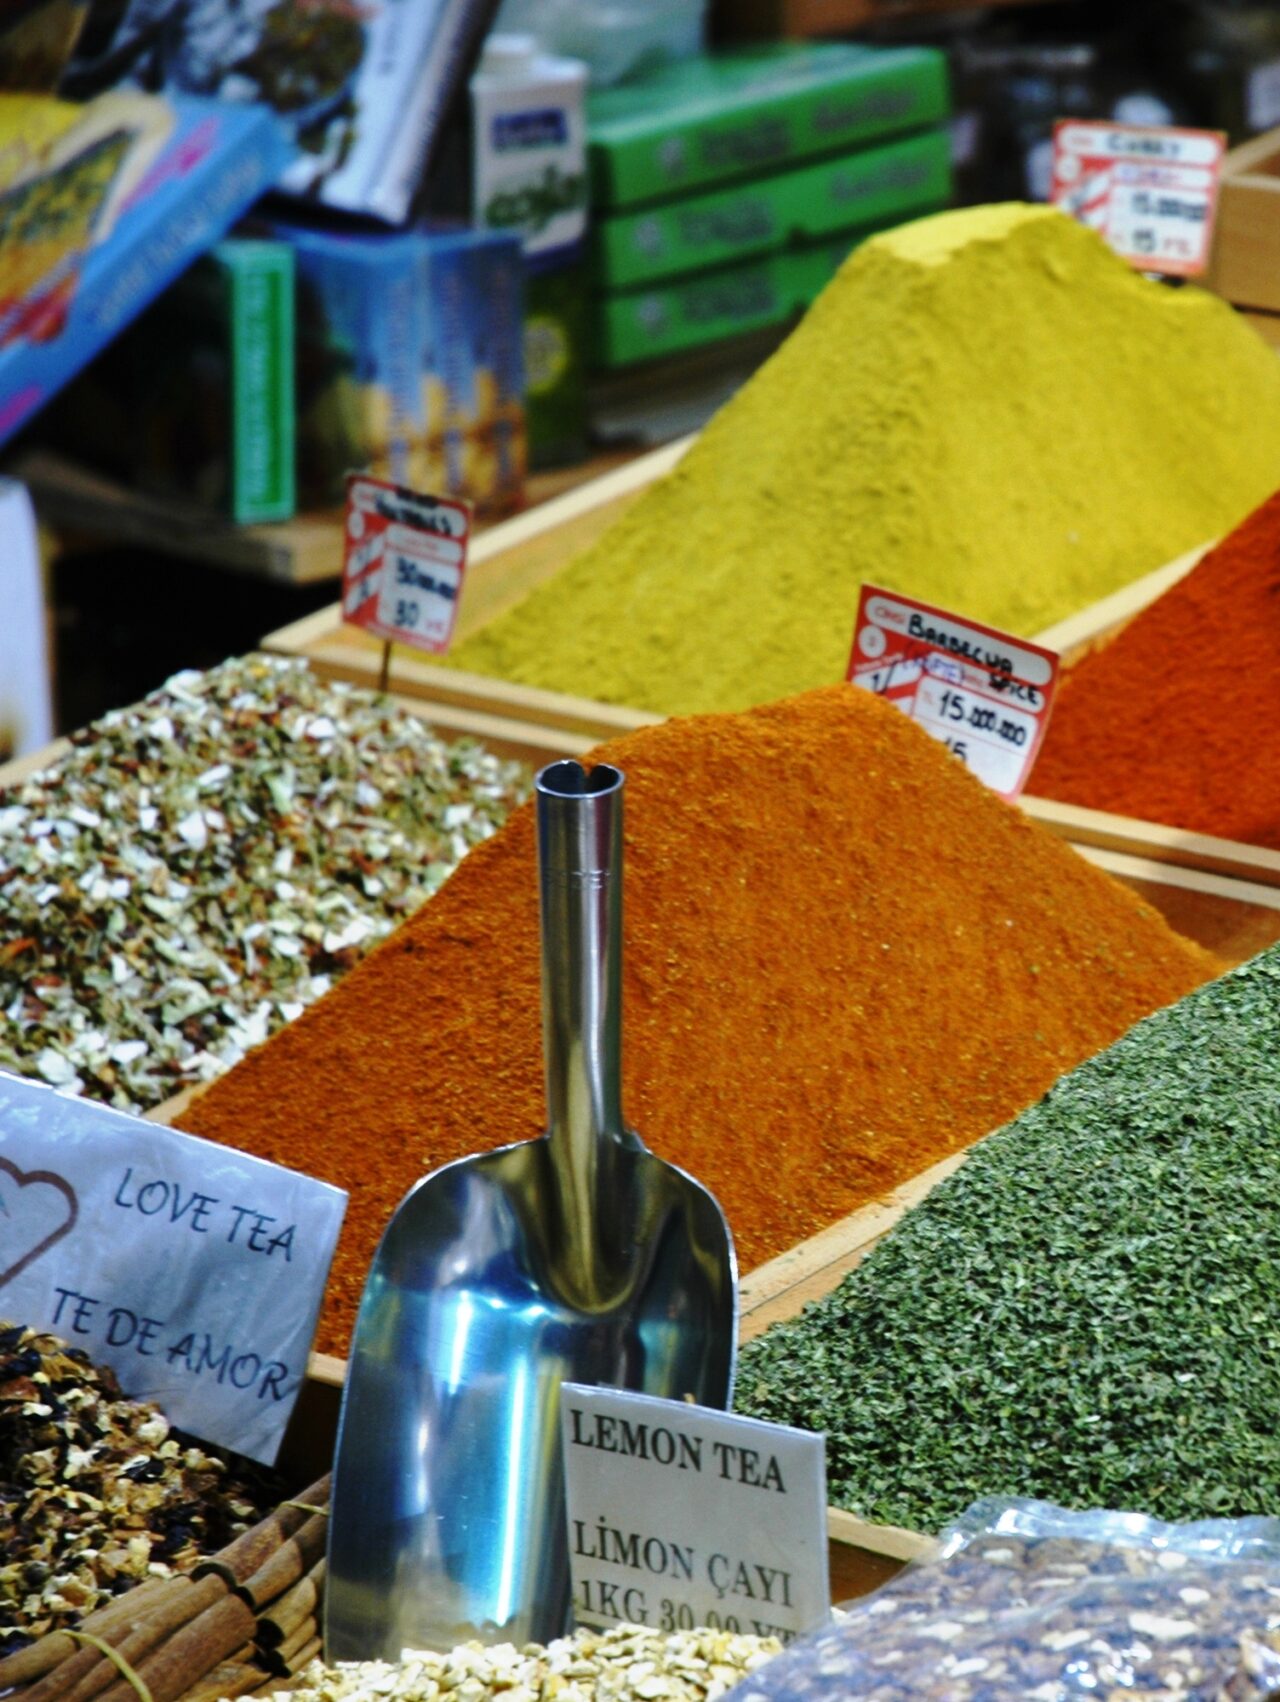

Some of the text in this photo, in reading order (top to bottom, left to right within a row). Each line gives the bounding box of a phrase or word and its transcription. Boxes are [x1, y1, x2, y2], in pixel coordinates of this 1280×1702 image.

[113, 1168, 298, 1262] LOVE TEA
[52, 1287, 290, 1400] TE DE AMOR
[570, 1409, 787, 1493] LEMON TEA
[581, 1580, 648, 1625] 1KG
[708, 1553, 794, 1608] ÇAYI
